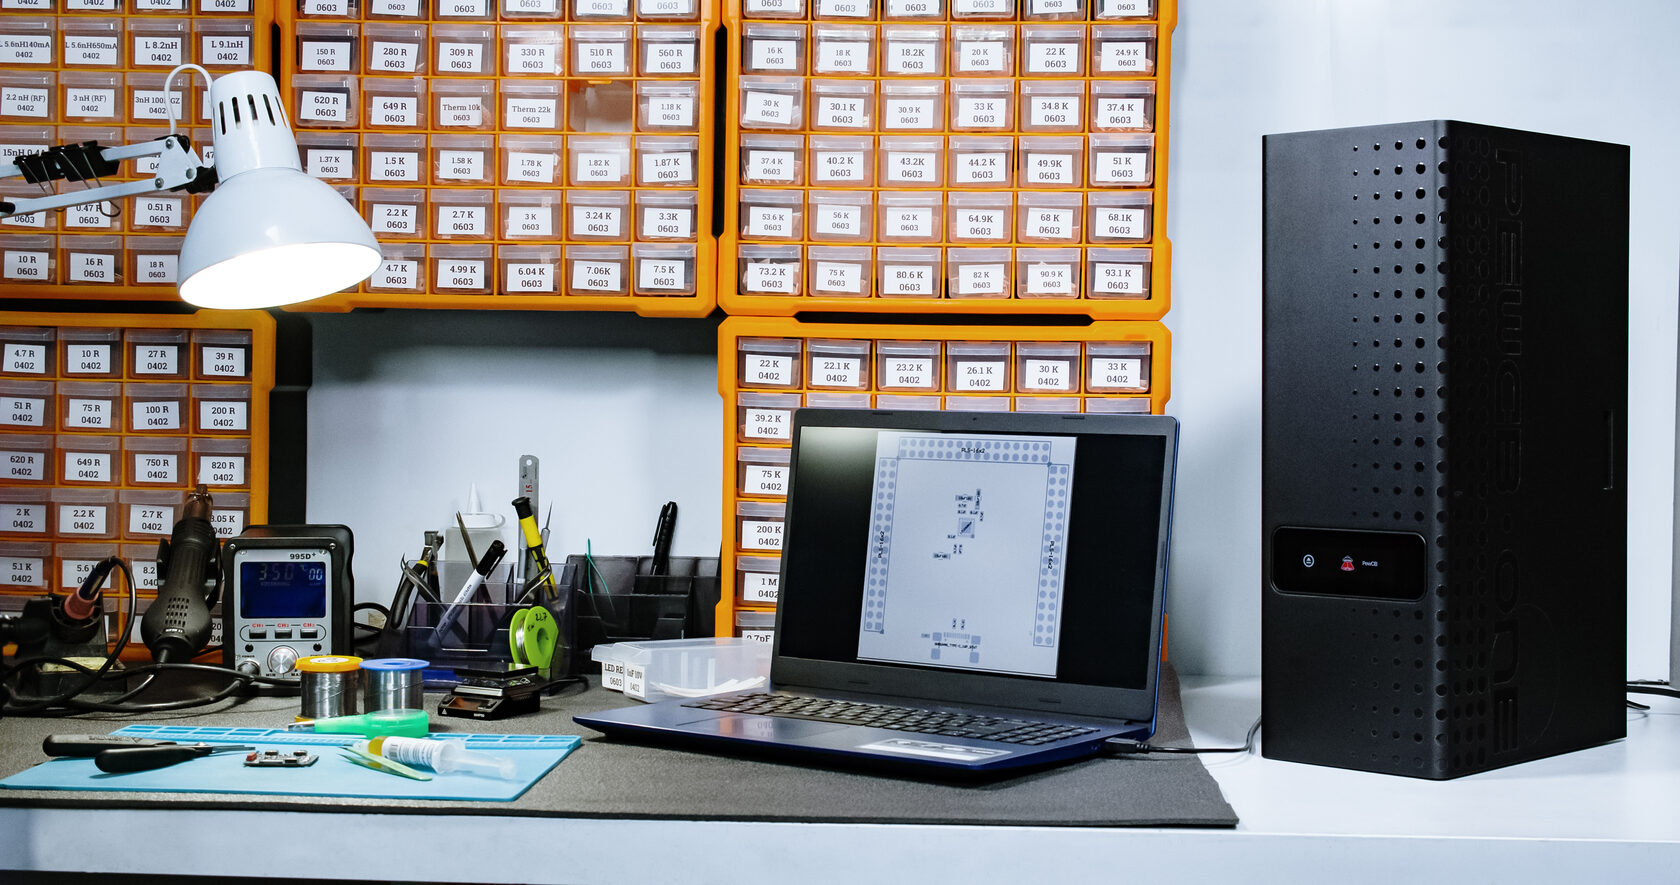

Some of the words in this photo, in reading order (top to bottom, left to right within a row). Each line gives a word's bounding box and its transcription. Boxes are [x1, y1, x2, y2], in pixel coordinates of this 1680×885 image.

[316, 4, 337, 12] 0603
[145, 41, 151, 49] L
[152, 41, 178, 49] 8.2nH
[211, 40, 217, 48] L
[218, 40, 243, 48] 9.1nH
[383, 47, 399, 56] 280
[400, 48, 407, 56] R
[151, 53, 172, 62] 0402
[217, 52, 238, 60] 0402
[384, 60, 405, 68] 0603
[30, 94, 46, 103] (RF)
[73, 94, 78, 102] 3
[314, 96, 330, 104] 620
[332, 97, 339, 105] R
[17, 104, 34, 112] 0402
[383, 102, 398, 110] 649
[400, 102, 407, 110] R
[1107, 104, 1125, 112] 37.4
[1127, 104, 1134, 112] K
[315, 108, 336, 117] 0603
[384, 114, 405, 122] 0603
[1110, 116, 1131, 124] 0603
[385, 157, 396, 165] 1.5
[398, 157, 405, 165] K
[900, 158, 925, 166] 43.2K
[968, 158, 987, 166] 44.2
[989, 158, 996, 166] K
[1037, 160, 1062, 168] 49.9K
[1113, 157, 1122, 165] 51
[1125, 157, 1132, 165] K
[384, 169, 406, 177] 0603
[901, 170, 923, 178] 0603
[972, 170, 993, 179] 0603
[1038, 172, 1060, 180] 0603
[1111, 170, 1133, 178] 0603
[147, 203, 164, 211] 0.51
[166, 204, 172, 212] R
[386, 208, 399, 216] 2.2
[401, 209, 408, 217] K
[452, 210, 466, 218] 2.7
[467, 210, 474, 218] K
[149, 215, 170, 224] 0603
[968, 214, 993, 223] 64.9K
[1040, 214, 1051, 222] 68
[1053, 214, 1060, 222] K
[1108, 213, 1132, 222] 68.1K
[386, 220, 408, 229] 0603
[452, 222, 474, 231] 0603
[970, 227, 991, 236] 0603
[1039, 226, 1060, 235] 0603
[1108, 226, 1130, 234] 0603
[30, 256, 36, 264] R
[86, 258, 95, 266] 16
[96, 258, 103, 266] R
[16, 267, 38, 276] 0603
[386, 264, 399, 272] 4.7
[400, 264, 407, 272] K
[450, 265, 468, 274] 4.99
[470, 266, 476, 274] K
[518, 268, 536, 276] 6.04
[586, 266, 611, 275] 7.06K
[759, 267, 777, 276] 73.2
[779, 268, 786, 276] K
[84, 270, 104, 278] 0603
[896, 271, 915, 279] 80.6
[917, 271, 923, 279] K
[1105, 268, 1122, 277] 93.1
[1125, 269, 1131, 277] K
[386, 276, 407, 284] 0603
[452, 277, 474, 286] 0603
[521, 280, 542, 288] 0603
[588, 278, 608, 288] 0603
[761, 280, 783, 288] 0603
[899, 283, 920, 291] 0603
[1107, 281, 1129, 290] 0603
[148, 350, 158, 358] 27
[160, 350, 166, 358] R
[216, 352, 226, 360] 39
[228, 352, 234, 360] R
[147, 362, 168, 370] 0402
[760, 359, 770, 368] 22
[772, 360, 779, 368] K
[824, 362, 841, 370] 22.1
[843, 362, 850, 370] K
[214, 364, 235, 372] 0402
[1039, 365, 1050, 373] 30
[758, 372, 780, 380] 0402
[826, 374, 848, 382] 0402
[1038, 377, 1059, 386] 0402
[82, 404, 92, 412] 75
[94, 404, 101, 412] R
[146, 406, 161, 414] 100
[211, 406, 227, 414] 200
[81, 416, 102, 424] 0402
[148, 418, 168, 426] 0402
[213, 418, 234, 427] 0402
[755, 414, 773, 422] 39.2
[775, 415, 782, 423] K
[757, 427, 778, 436] 0402
[77, 458, 92, 466] 649
[94, 458, 100, 466] R
[146, 458, 161, 467] 750
[211, 461, 227, 470] 820
[78, 470, 99, 478] 0402
[147, 470, 168, 479] 0402
[213, 474, 234, 482] 0402
[762, 470, 772, 478] 75
[774, 470, 781, 478] K
[760, 482, 782, 491] 0402
[73, 509, 86, 518] 2.2
[88, 510, 95, 518] K
[142, 510, 155, 518] 2.7
[156, 511, 163, 519] K
[73, 522, 94, 530] 0402
[142, 522, 162, 531] 0402
[756, 525, 773, 534] 200
[775, 526, 781, 534] K
[758, 538, 780, 546] 0402
[605, 663, 615, 673] LED
[615, 665, 624, 674] RE
[610, 676, 622, 687] 0603
